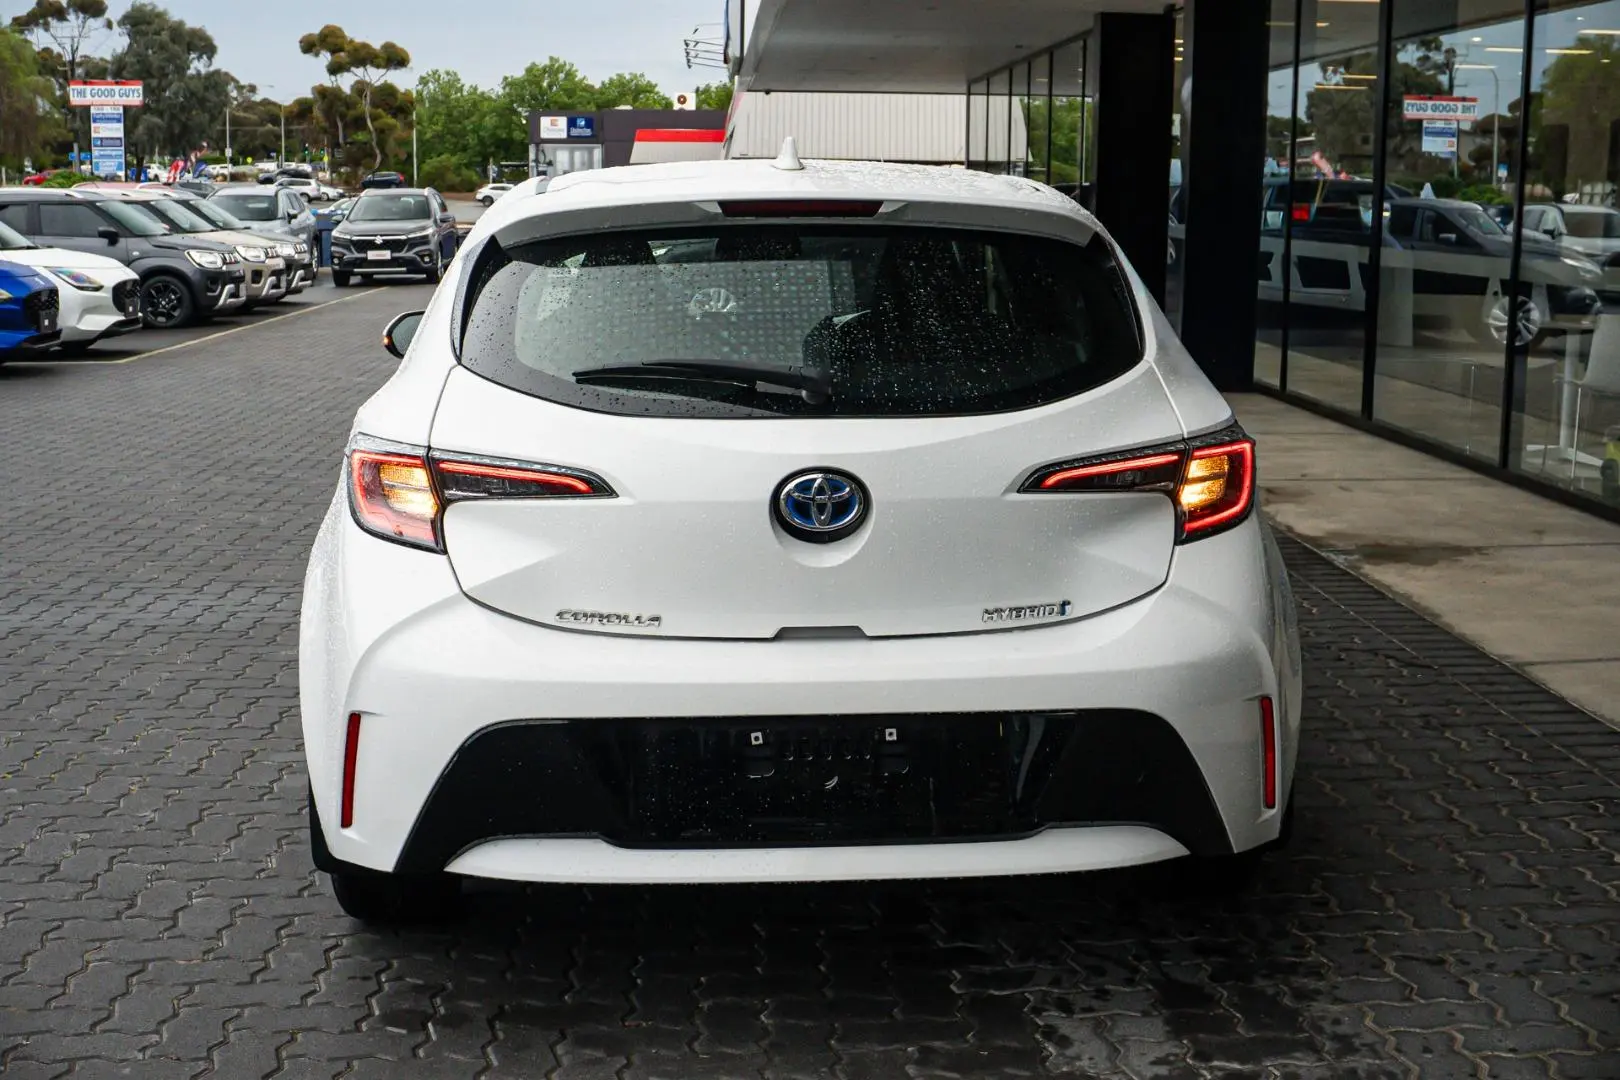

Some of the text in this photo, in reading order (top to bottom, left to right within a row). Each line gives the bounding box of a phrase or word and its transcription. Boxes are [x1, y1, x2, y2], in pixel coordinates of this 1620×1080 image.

[71, 88, 141, 98] THE GOOD GUYS
[556, 609, 662, 628] COROLLA
[982, 603, 1061, 623] HYBRID
